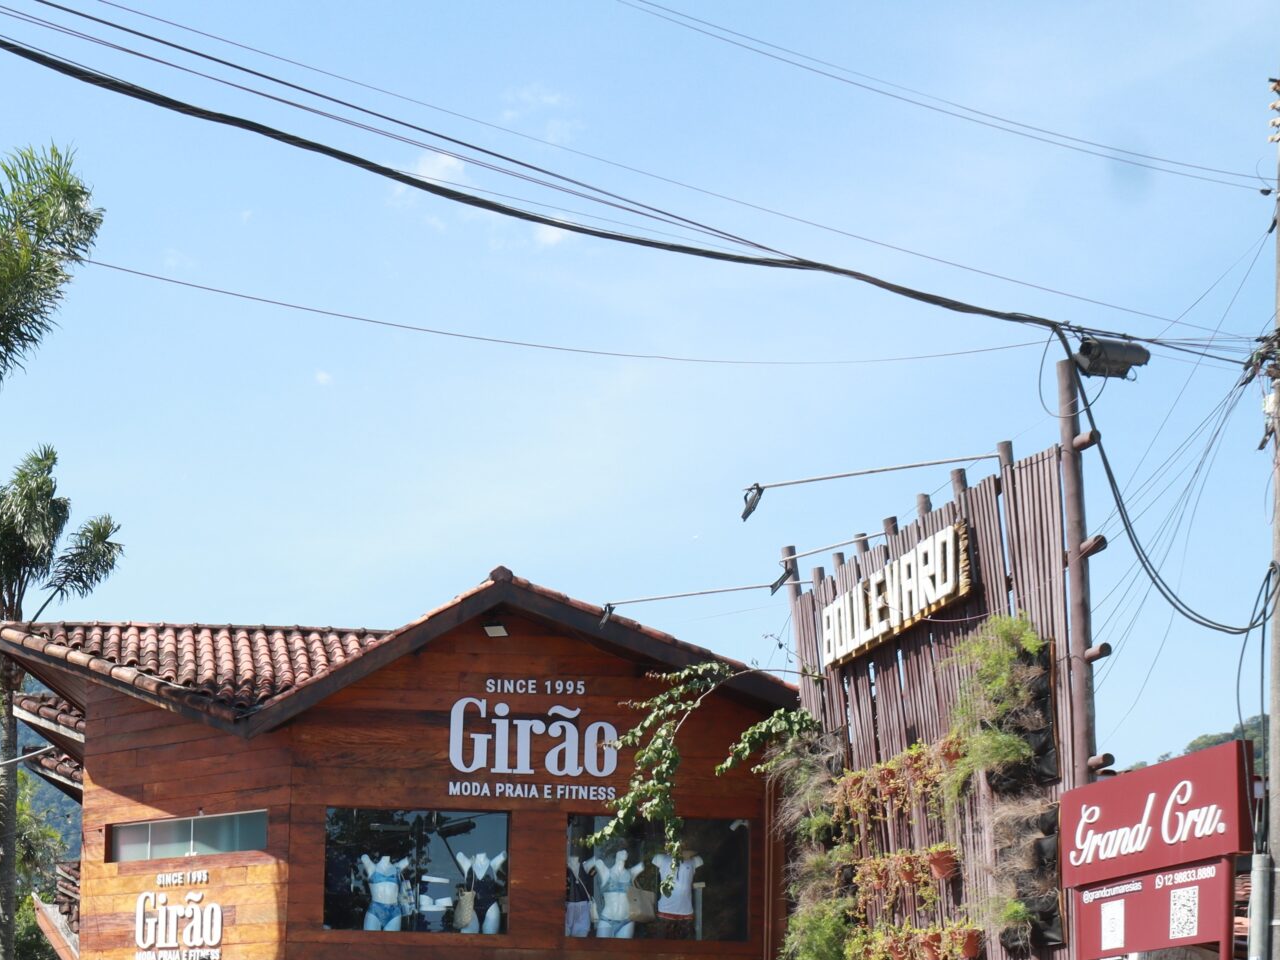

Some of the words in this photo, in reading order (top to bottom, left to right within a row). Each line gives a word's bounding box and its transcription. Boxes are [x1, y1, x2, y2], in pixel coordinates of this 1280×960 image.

[823, 525, 955, 667] BOULEVARD
[485, 678, 537, 693] SINCE
[545, 680, 585, 695] 1995
[449, 697, 618, 778] Girão
[448, 781, 490, 797] MODA
[495, 783, 538, 798] PRAIA
[544, 785, 552, 799] E
[557, 786, 616, 800] FITNESS
[1069, 792, 1157, 866] Grand
[156, 871, 185, 887] SINCE
[187, 870, 209, 885] 1995
[1164, 874, 1173, 886] 12
[135, 891, 223, 949] Girão
